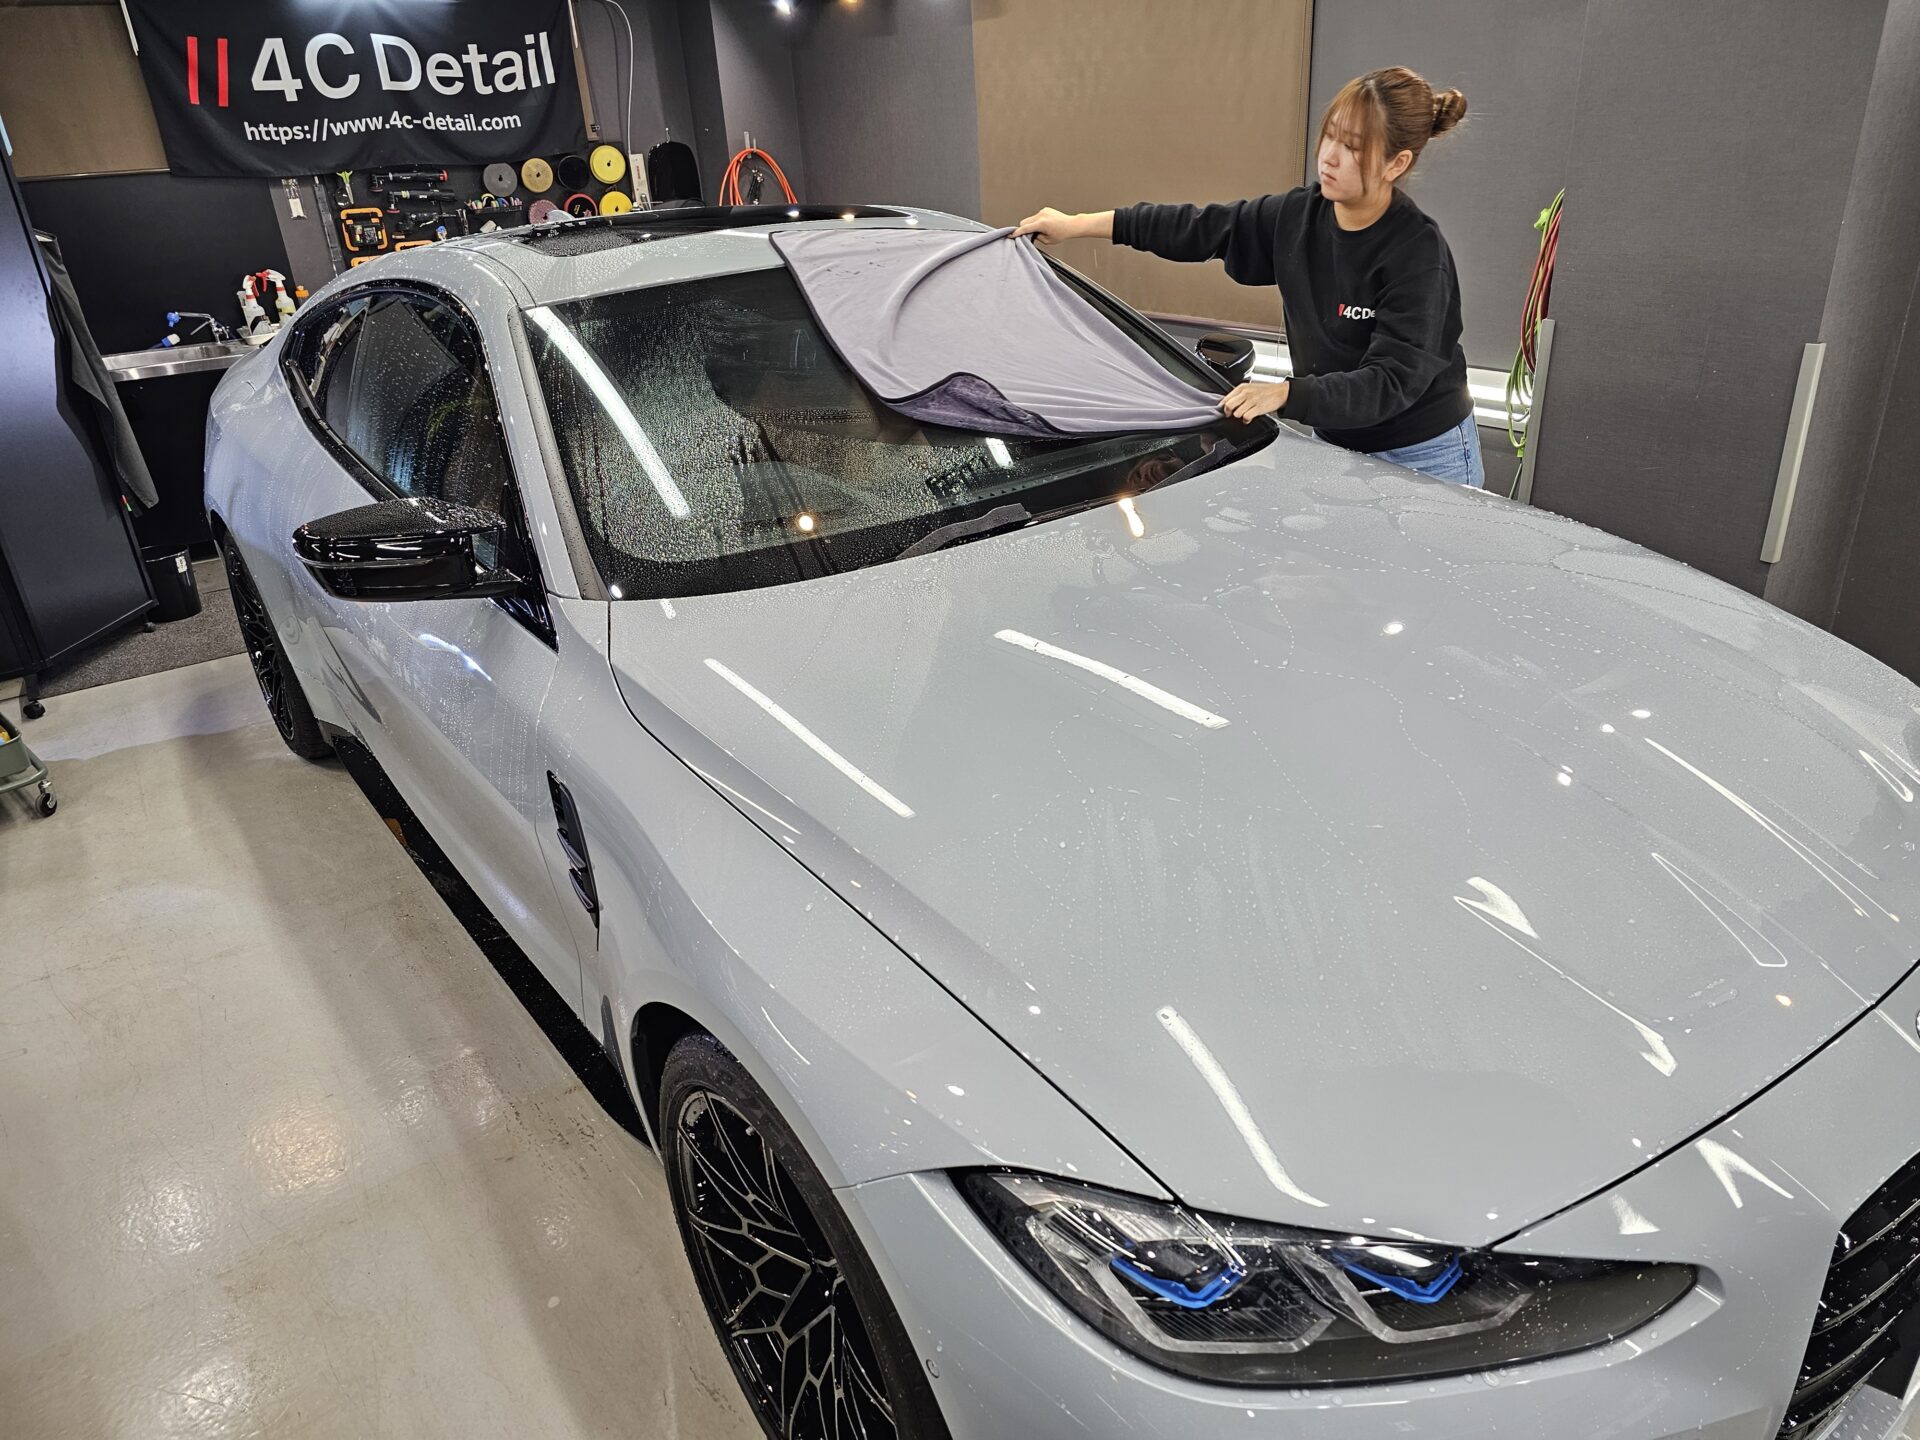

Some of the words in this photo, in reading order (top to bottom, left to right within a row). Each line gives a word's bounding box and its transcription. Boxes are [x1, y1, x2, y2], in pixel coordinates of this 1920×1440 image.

[251, 32, 361, 102] 4C
[371, 31, 556, 96] Detail
[243, 110, 522, 145] https://www.4c-detail.com
